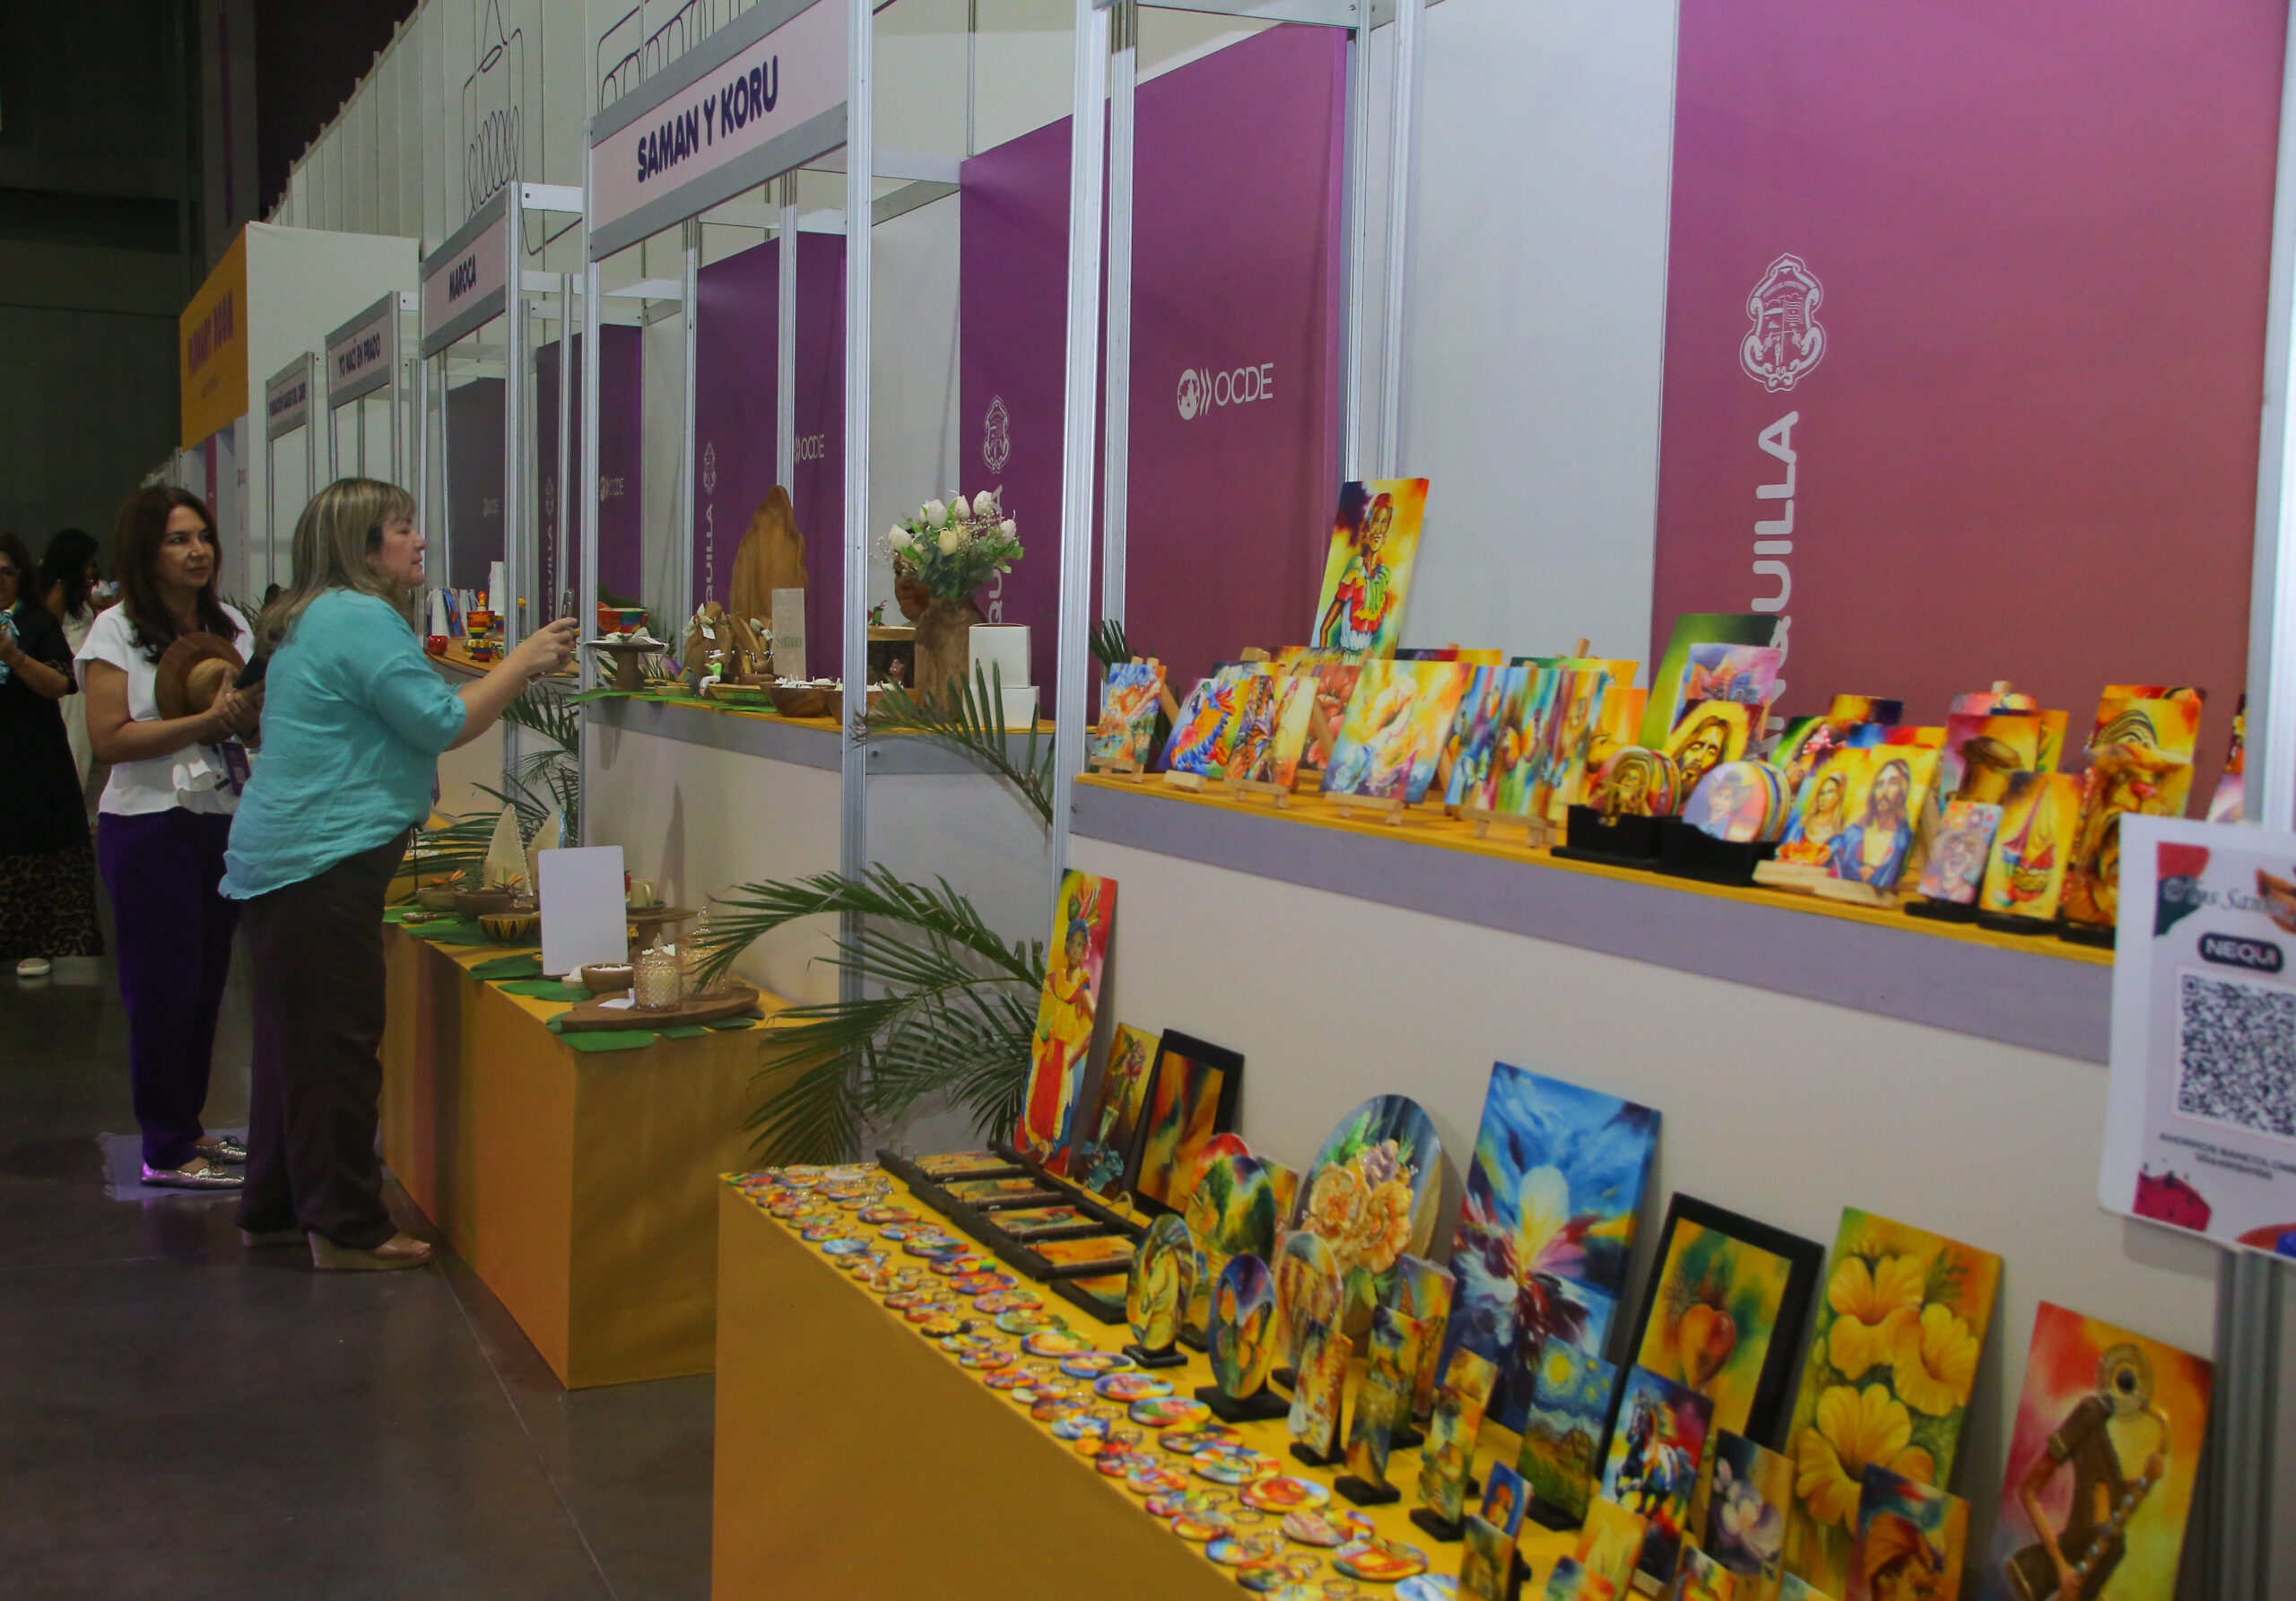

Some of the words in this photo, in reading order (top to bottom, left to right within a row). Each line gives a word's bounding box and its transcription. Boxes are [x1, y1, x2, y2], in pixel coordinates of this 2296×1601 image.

[638, 103, 699, 183] SAMAN
[704, 94, 716, 147] Y
[721, 54, 778, 139] KORU
[449, 254, 476, 304] MAROCA
[1214, 362, 1274, 406] OCDE
[801, 434, 824, 460] OCDE
[2205, 938, 2279, 965] NEQUI
